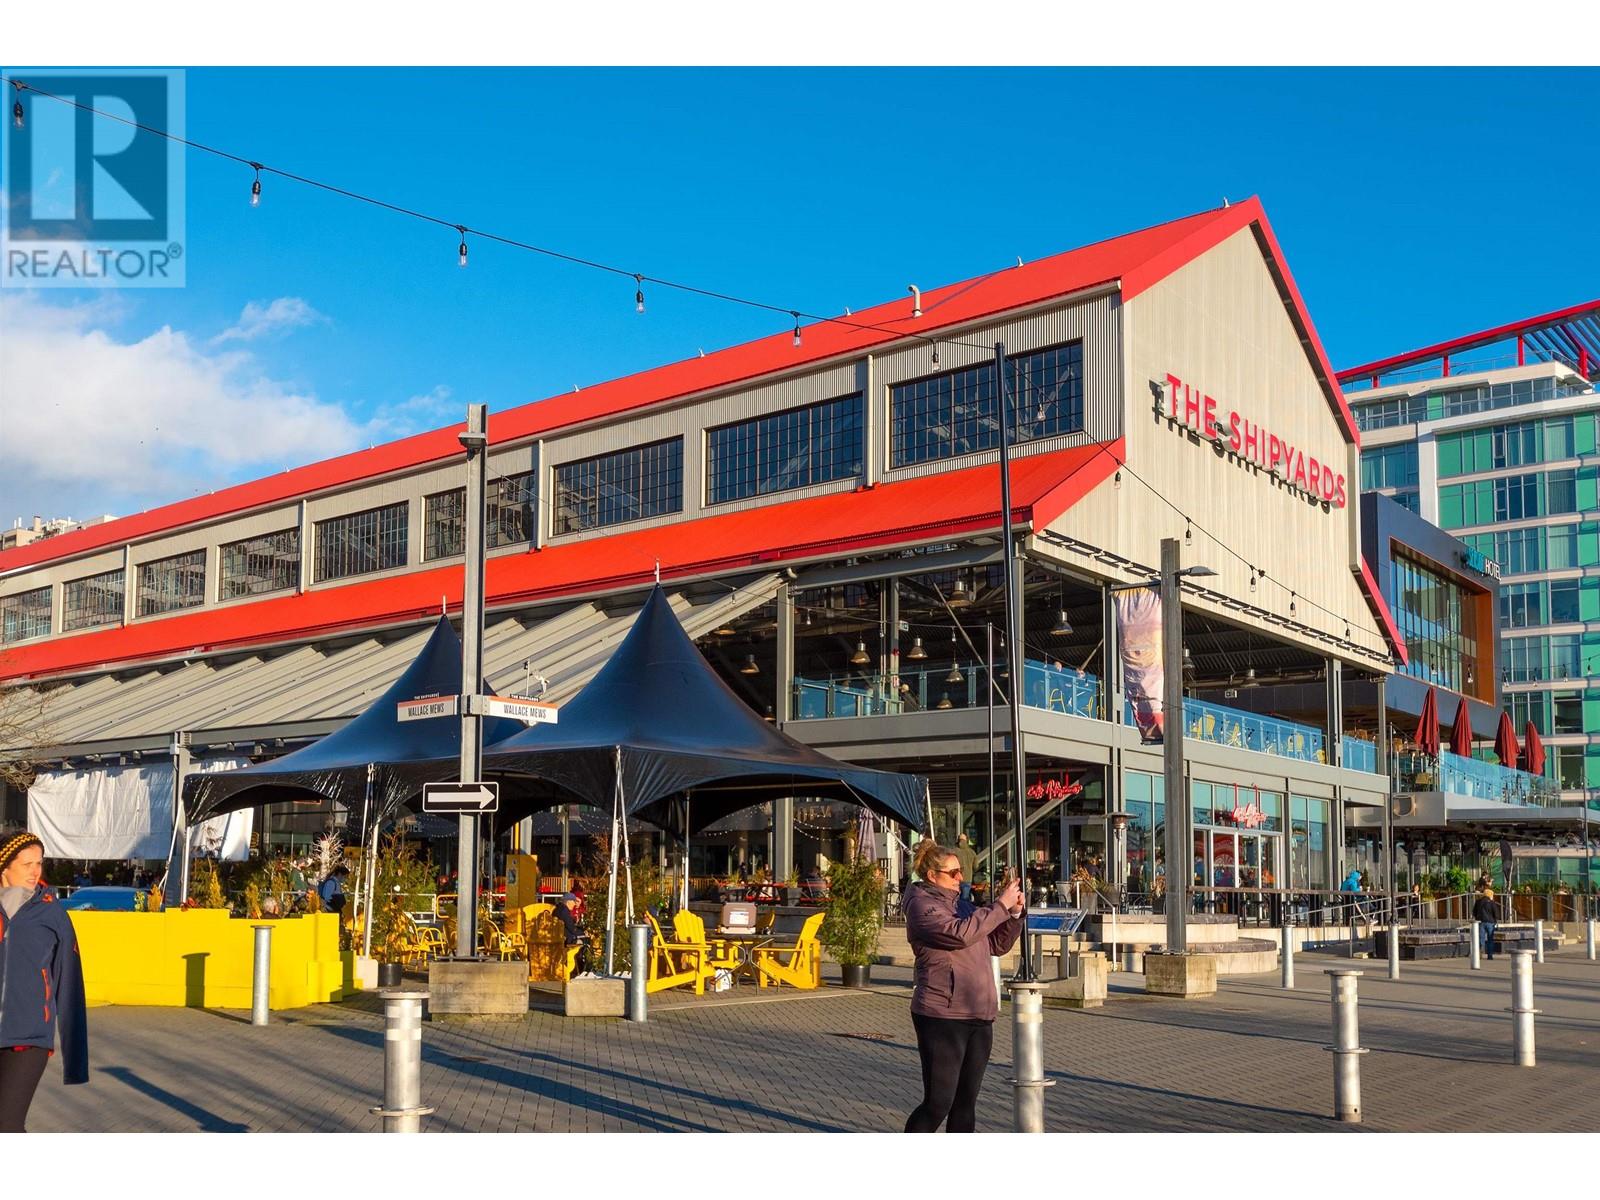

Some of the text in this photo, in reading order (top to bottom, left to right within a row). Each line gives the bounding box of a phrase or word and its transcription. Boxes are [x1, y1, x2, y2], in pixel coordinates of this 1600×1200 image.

[1166, 373, 1346, 509] THE SHIPYARDS
[1485, 558, 1502, 582] HOTEL
[408, 703, 445, 717] WALLACE MEWS
[504, 704, 547, 720] WALLACE MEWS
